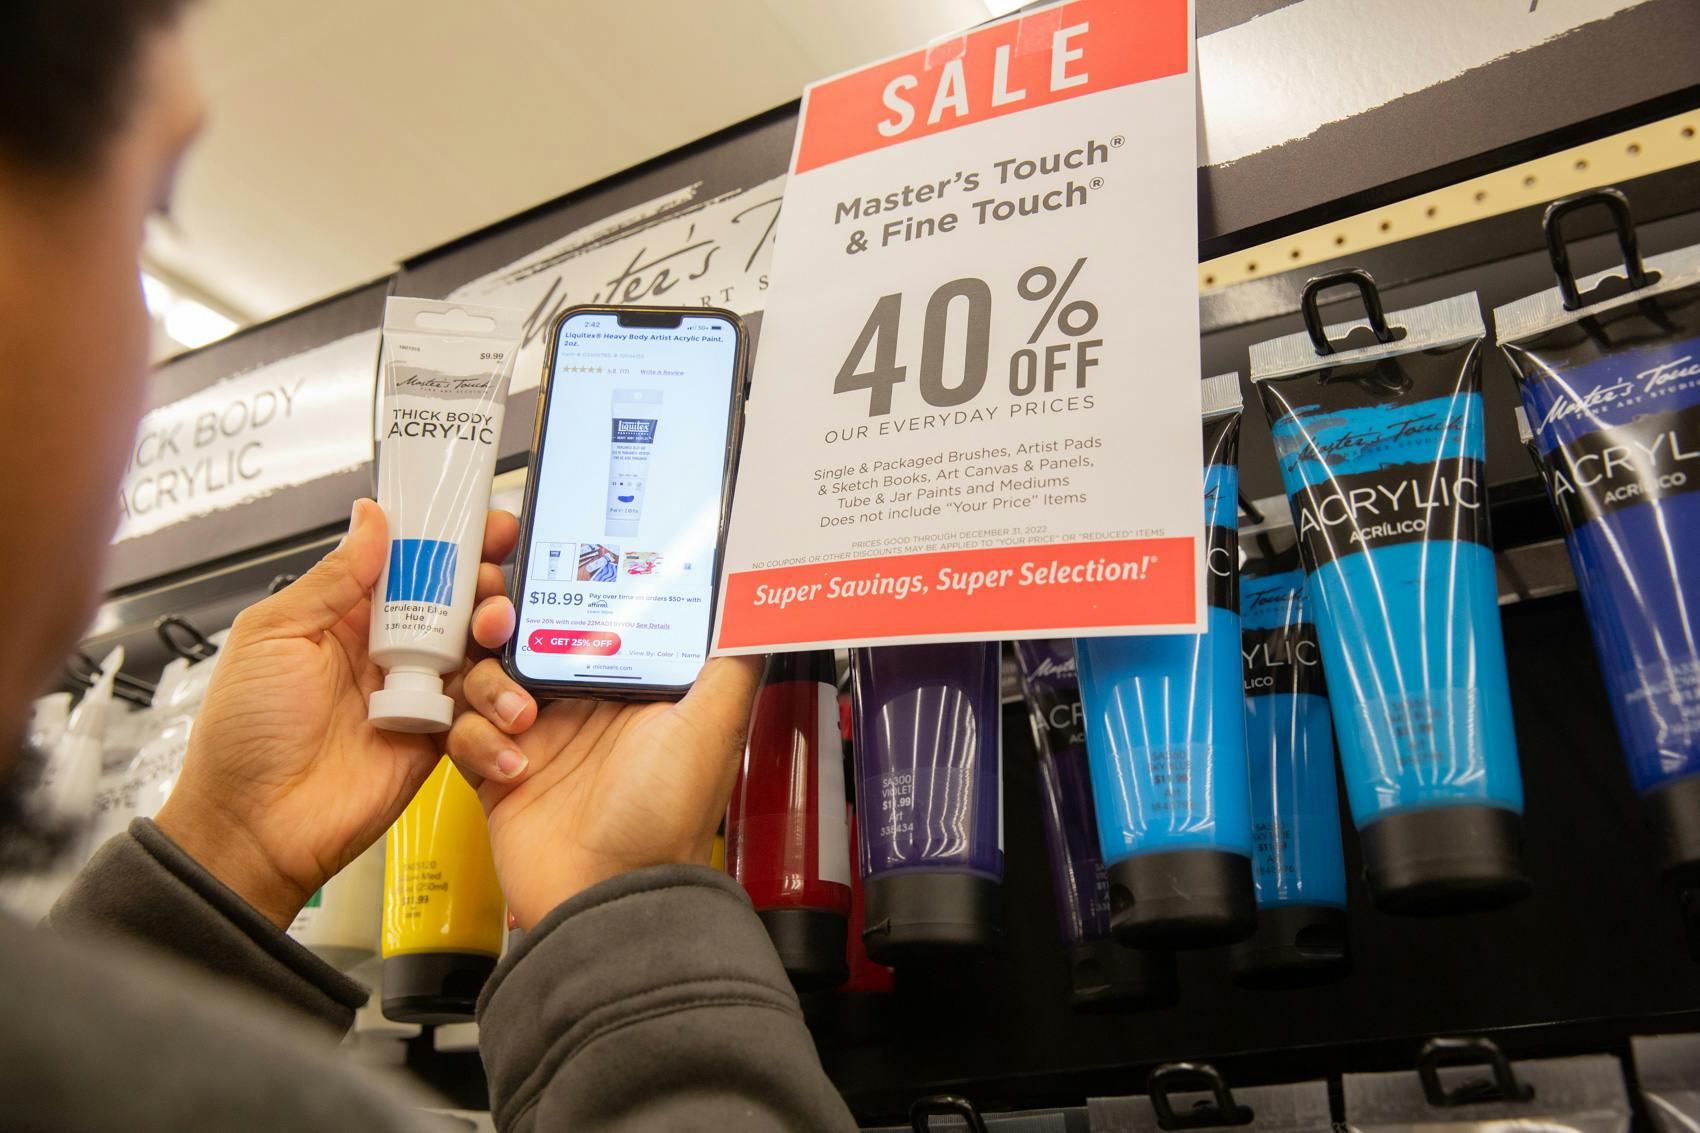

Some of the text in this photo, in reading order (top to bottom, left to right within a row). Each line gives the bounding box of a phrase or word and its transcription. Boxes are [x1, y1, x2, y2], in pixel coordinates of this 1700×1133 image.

[877, 22, 1089, 137] SALE
[834, 171, 980, 225] Master's
[845, 230, 868, 255] &
[881, 213, 958, 247] Fine
[603, 333, 627, 341] Heavy
[673, 335, 700, 343] Acrylic
[396, 374, 495, 389] Master's Touch
[1008, 338, 1103, 397] OFF
[192, 377, 306, 449] BODY
[393, 408, 493, 426] THICK BODY
[824, 395, 1095, 444] OUR EVERYDAY PRICES
[387, 421, 494, 444] ACRYLIC
[813, 436, 1102, 481] Single & Packaged Brushes, Artist Pads
[818, 455, 1094, 496] & Sketch Books, Art Canvas & Panels,
[820, 514, 855, 528] Does
[860, 510, 884, 523] not
[888, 504, 941, 520] include
[1044, 492, 1087, 505] Items
[838, 476, 1070, 509] Tube & Jar Paints and Mediums
[1300, 476, 1481, 543] ACRYLIC
[752, 561, 764, 570] NO
[766, 556, 807, 569] COUPONS
[808, 554, 821, 563] OR
[822, 551, 851, 562] OTHER
[852, 546, 903, 559] DISCOUNTS
[904, 545, 924, 553] MAY
[939, 541, 979, 551] APPLIED
[981, 539, 993, 547] TO
[1061, 533, 1076, 542] OR
[1135, 528, 1165, 537] ITEMS
[851, 539, 882, 549] PRICES
[883, 537, 911, 546] GOOD
[913, 532, 957, 543] THROUGH
[958, 528, 1010, 539] DECEMBER
[1025, 525, 1048, 534] 2022
[529, 591, 584, 606] $18.99
[588, 592, 602, 601] Pay
[753, 582, 822, 609] Super
[826, 572, 929, 600] Savings,
[936, 567, 1013, 596] Super
[405, 613, 425, 622] Hue
[550, 637, 613, 648] GET 25% OFF
